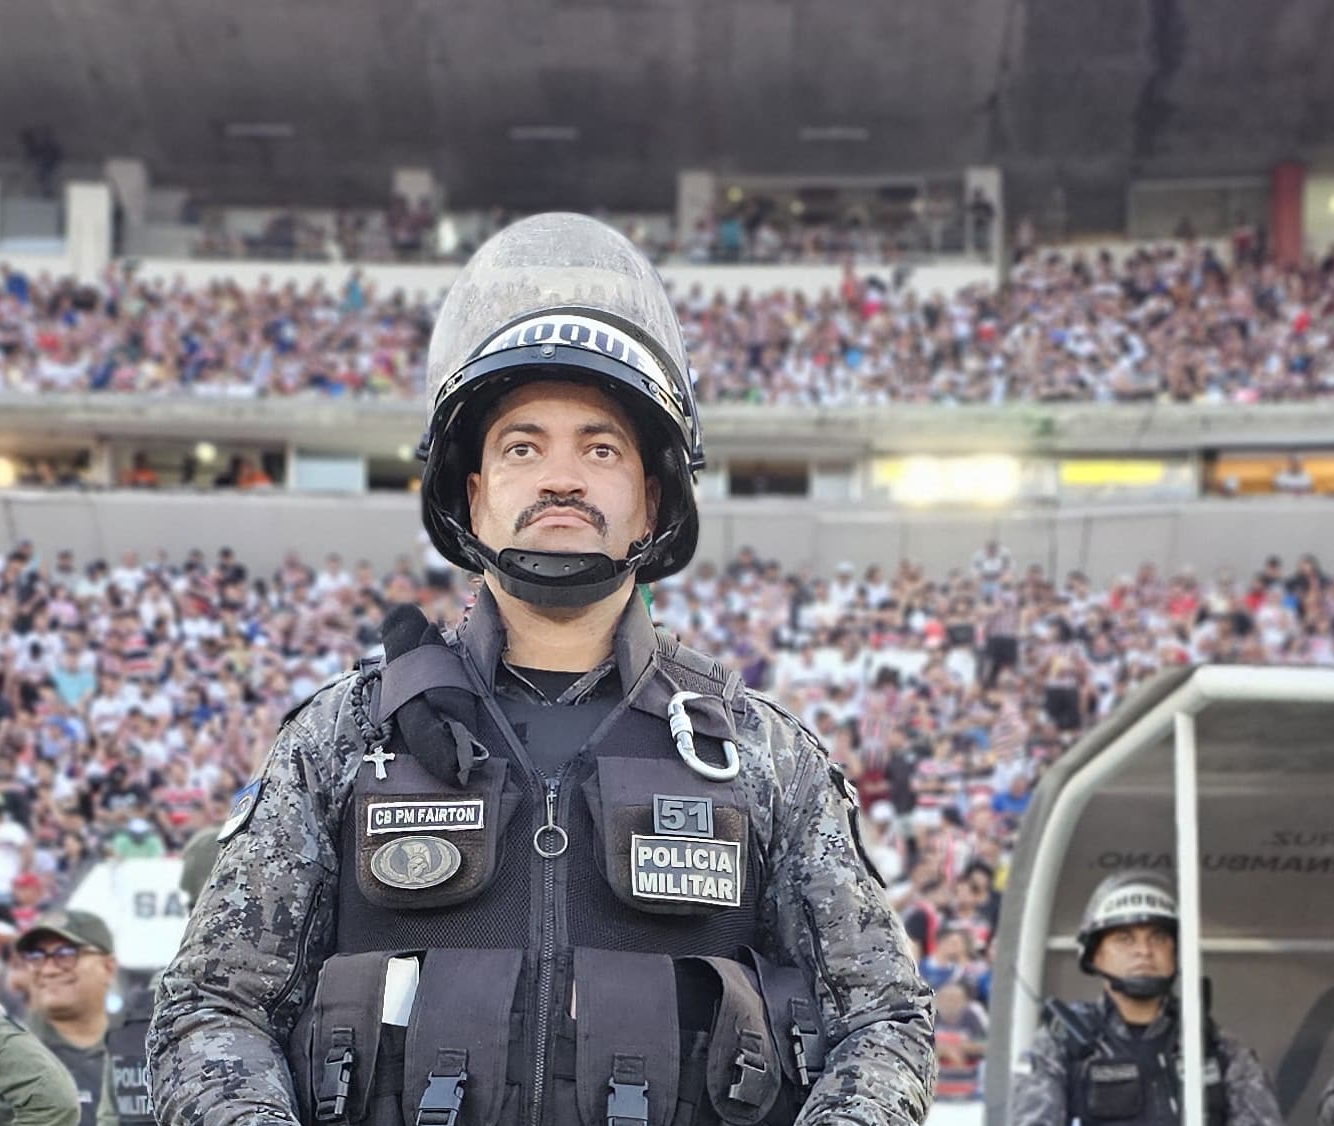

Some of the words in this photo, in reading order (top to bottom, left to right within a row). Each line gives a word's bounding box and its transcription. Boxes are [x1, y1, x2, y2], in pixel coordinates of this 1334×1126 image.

[375, 809, 392, 825] CB
[395, 808, 415, 823] PM
[417, 807, 475, 823] FAIRTON
[660, 800, 708, 831] 51
[637, 843, 733, 873] POLÍCIA
[638, 871, 733, 900] MILITAR
